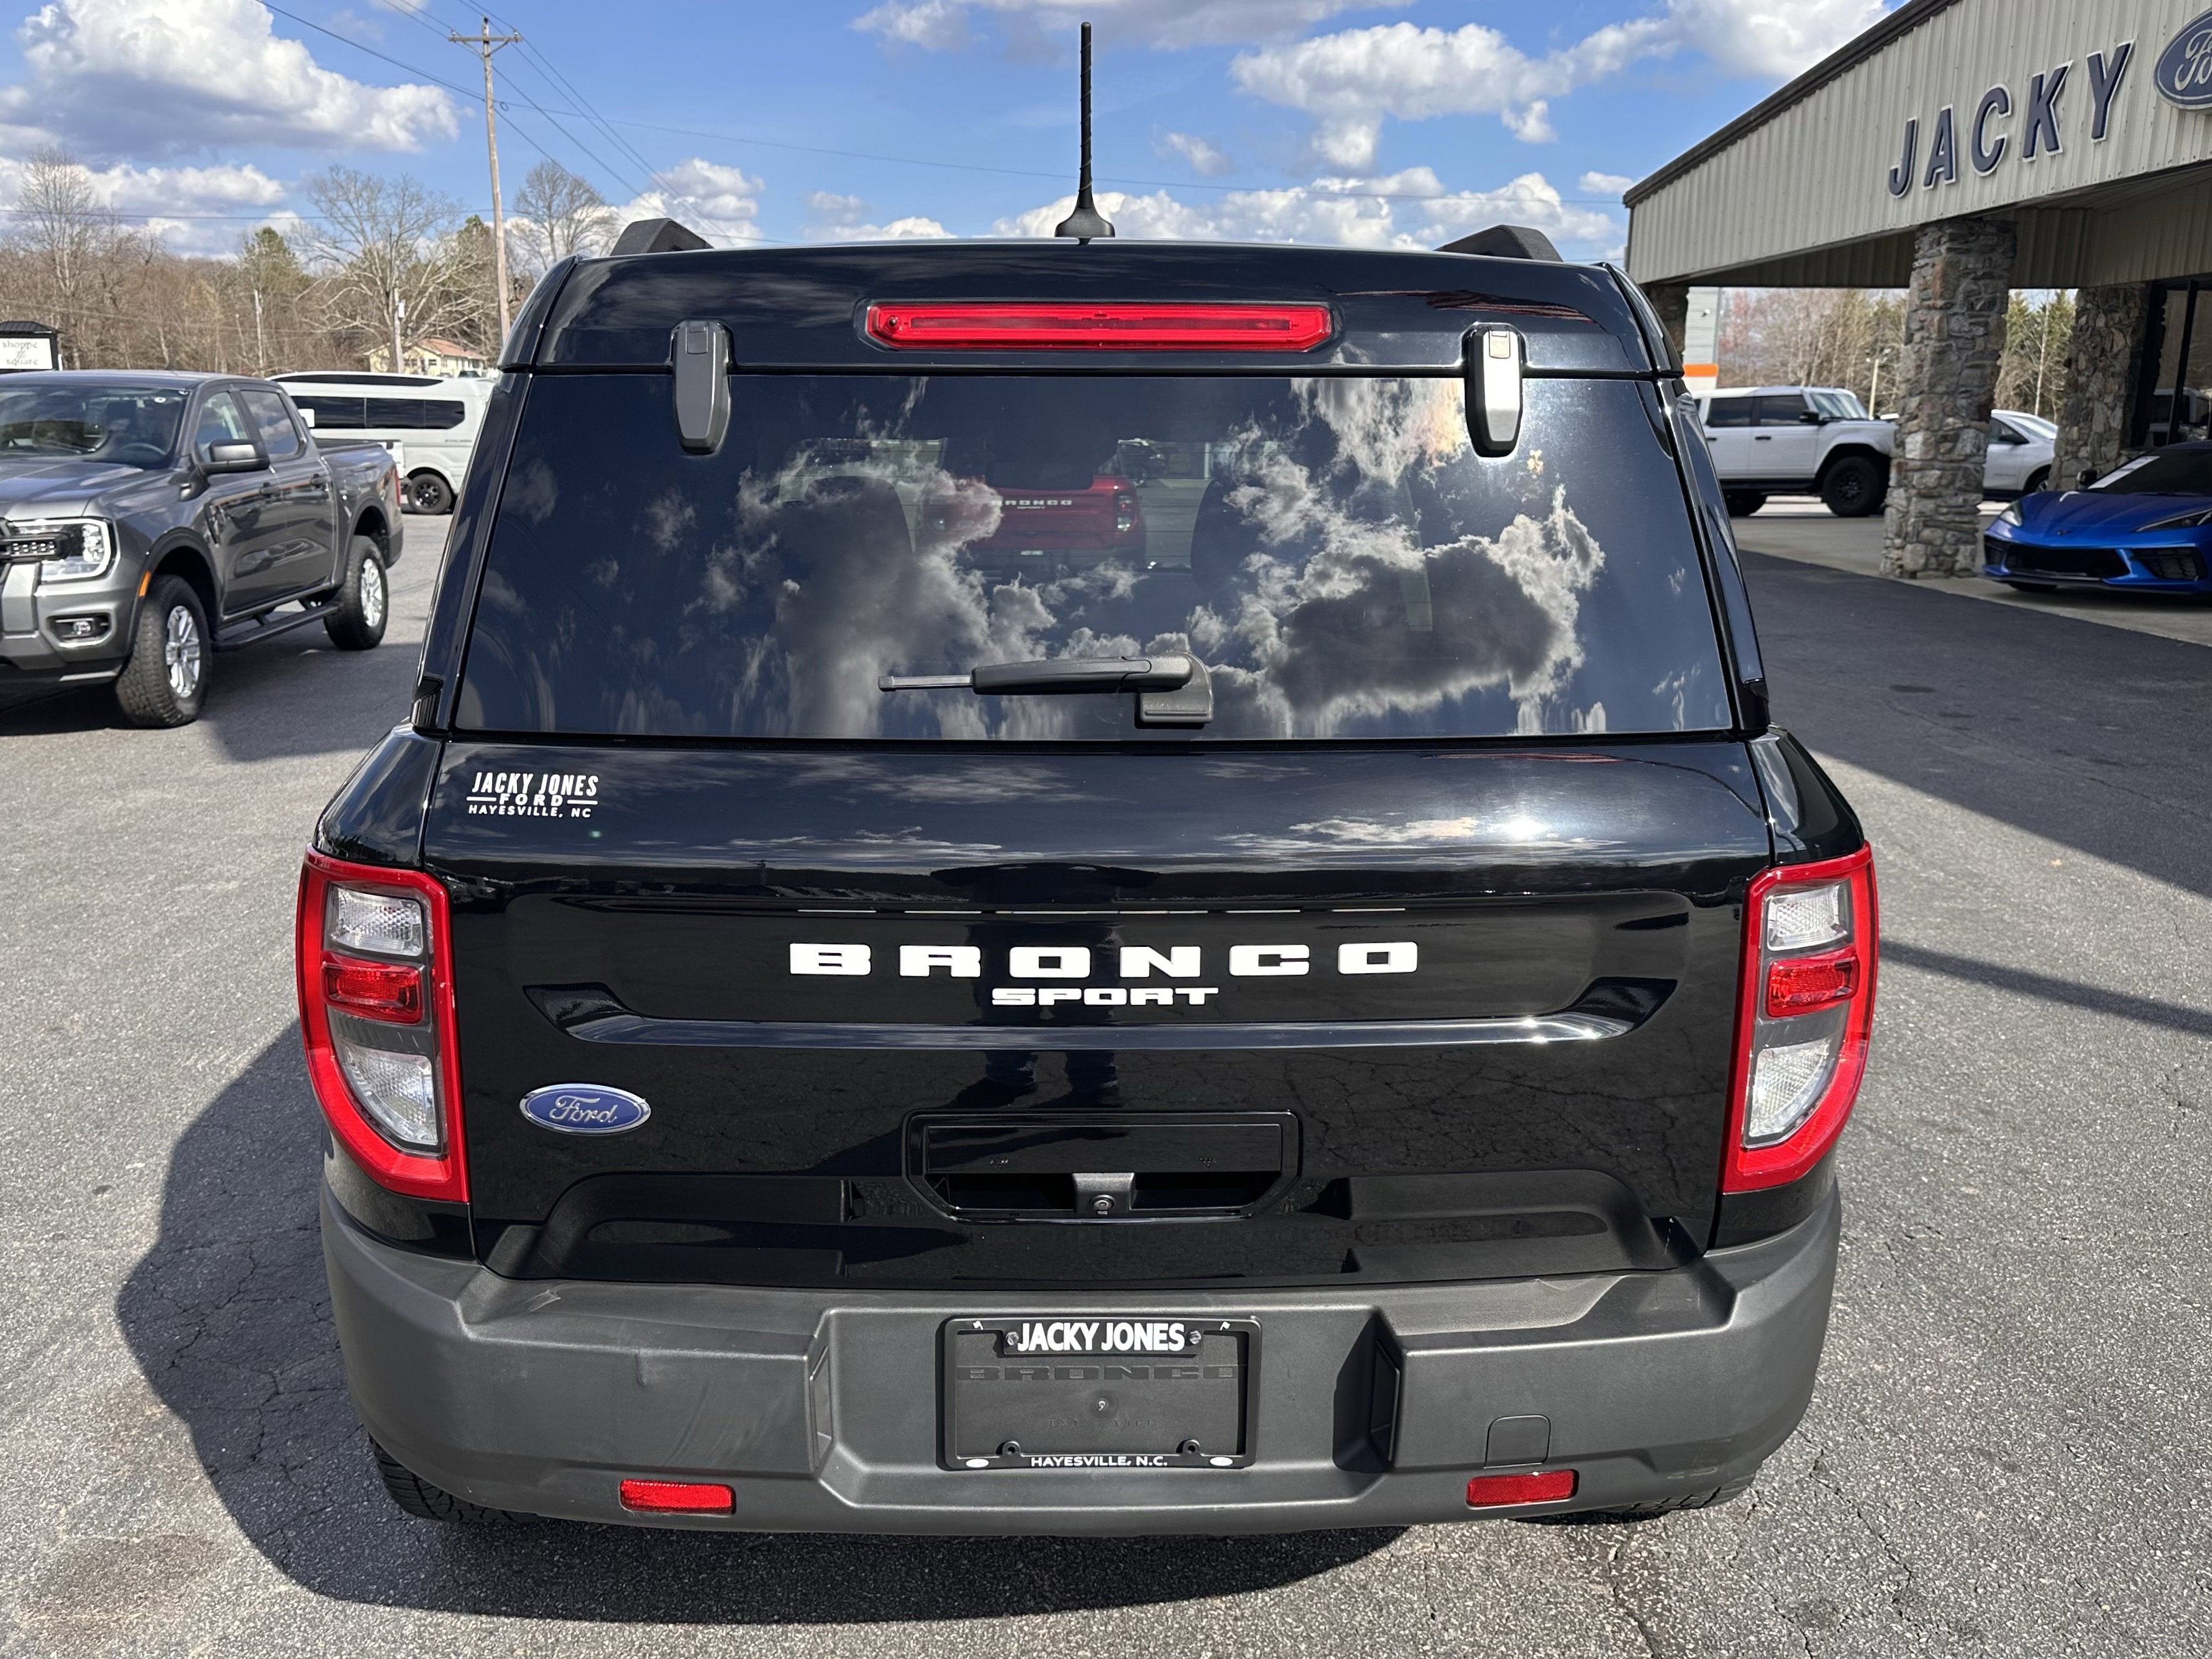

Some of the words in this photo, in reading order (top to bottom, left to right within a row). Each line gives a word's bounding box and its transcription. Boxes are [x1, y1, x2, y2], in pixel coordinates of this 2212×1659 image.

[1888, 39, 2134, 198] JACKY
[472, 772, 534, 794] JACKY
[538, 774, 599, 797] JONES
[499, 793, 564, 807] FORD
[468, 805, 564, 818] HAYESVILLE,
[571, 808, 592, 818] NC
[789, 941, 1419, 977] BRONCO
[992, 987, 1219, 1006] SPORT
[549, 1095, 618, 1123] Ford
[1017, 1322, 1100, 1351] JACKY
[1101, 1322, 1186, 1351] JONES
[957, 1364, 1239, 1381] BRONCO
[1030, 1455, 1132, 1466] HAYESVILLE,
[1136, 1455, 1168, 1466] N.C.
